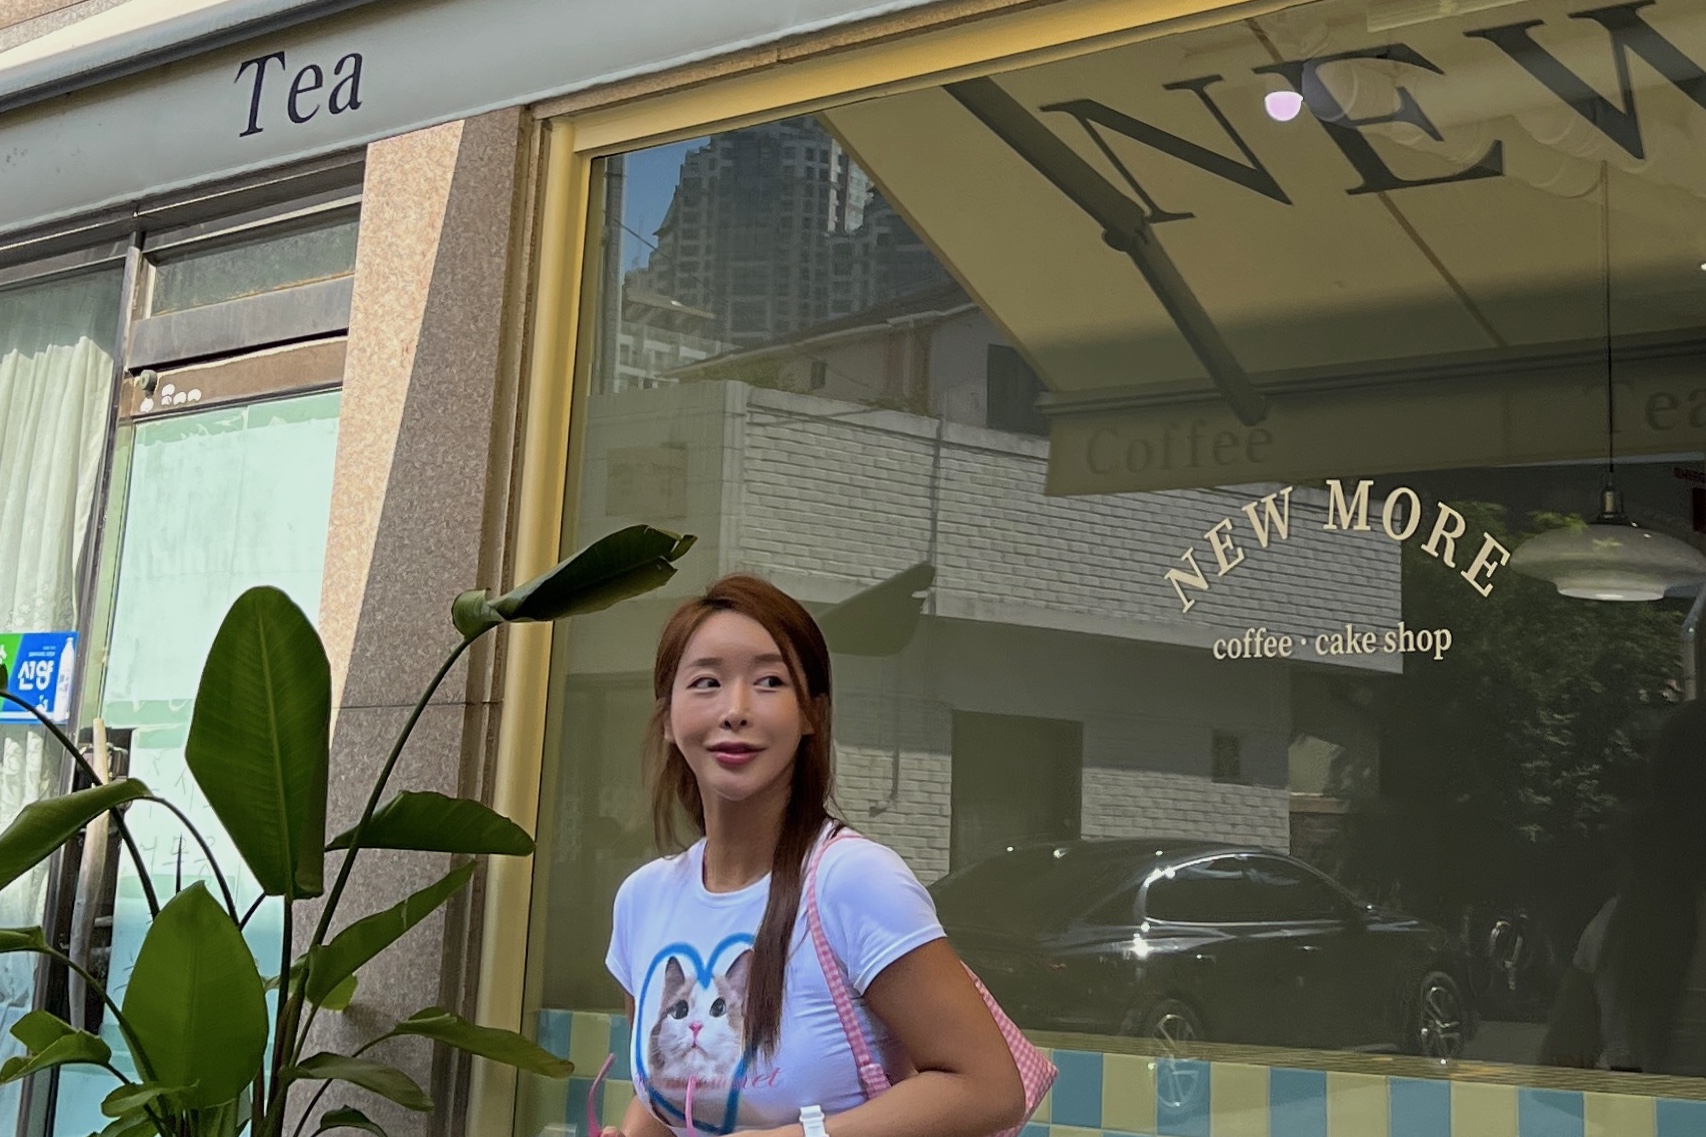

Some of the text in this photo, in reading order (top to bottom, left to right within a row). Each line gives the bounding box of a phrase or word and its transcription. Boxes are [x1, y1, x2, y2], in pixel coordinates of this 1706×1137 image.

[234, 51, 363, 138] Tea
[1086, 418, 1273, 475] Coffee
[1163, 479, 1511, 614] NEW MORE
[1213, 628, 1292, 660] coffee
[1314, 623, 1377, 657] cake
[1383, 621, 1453, 660] shop
